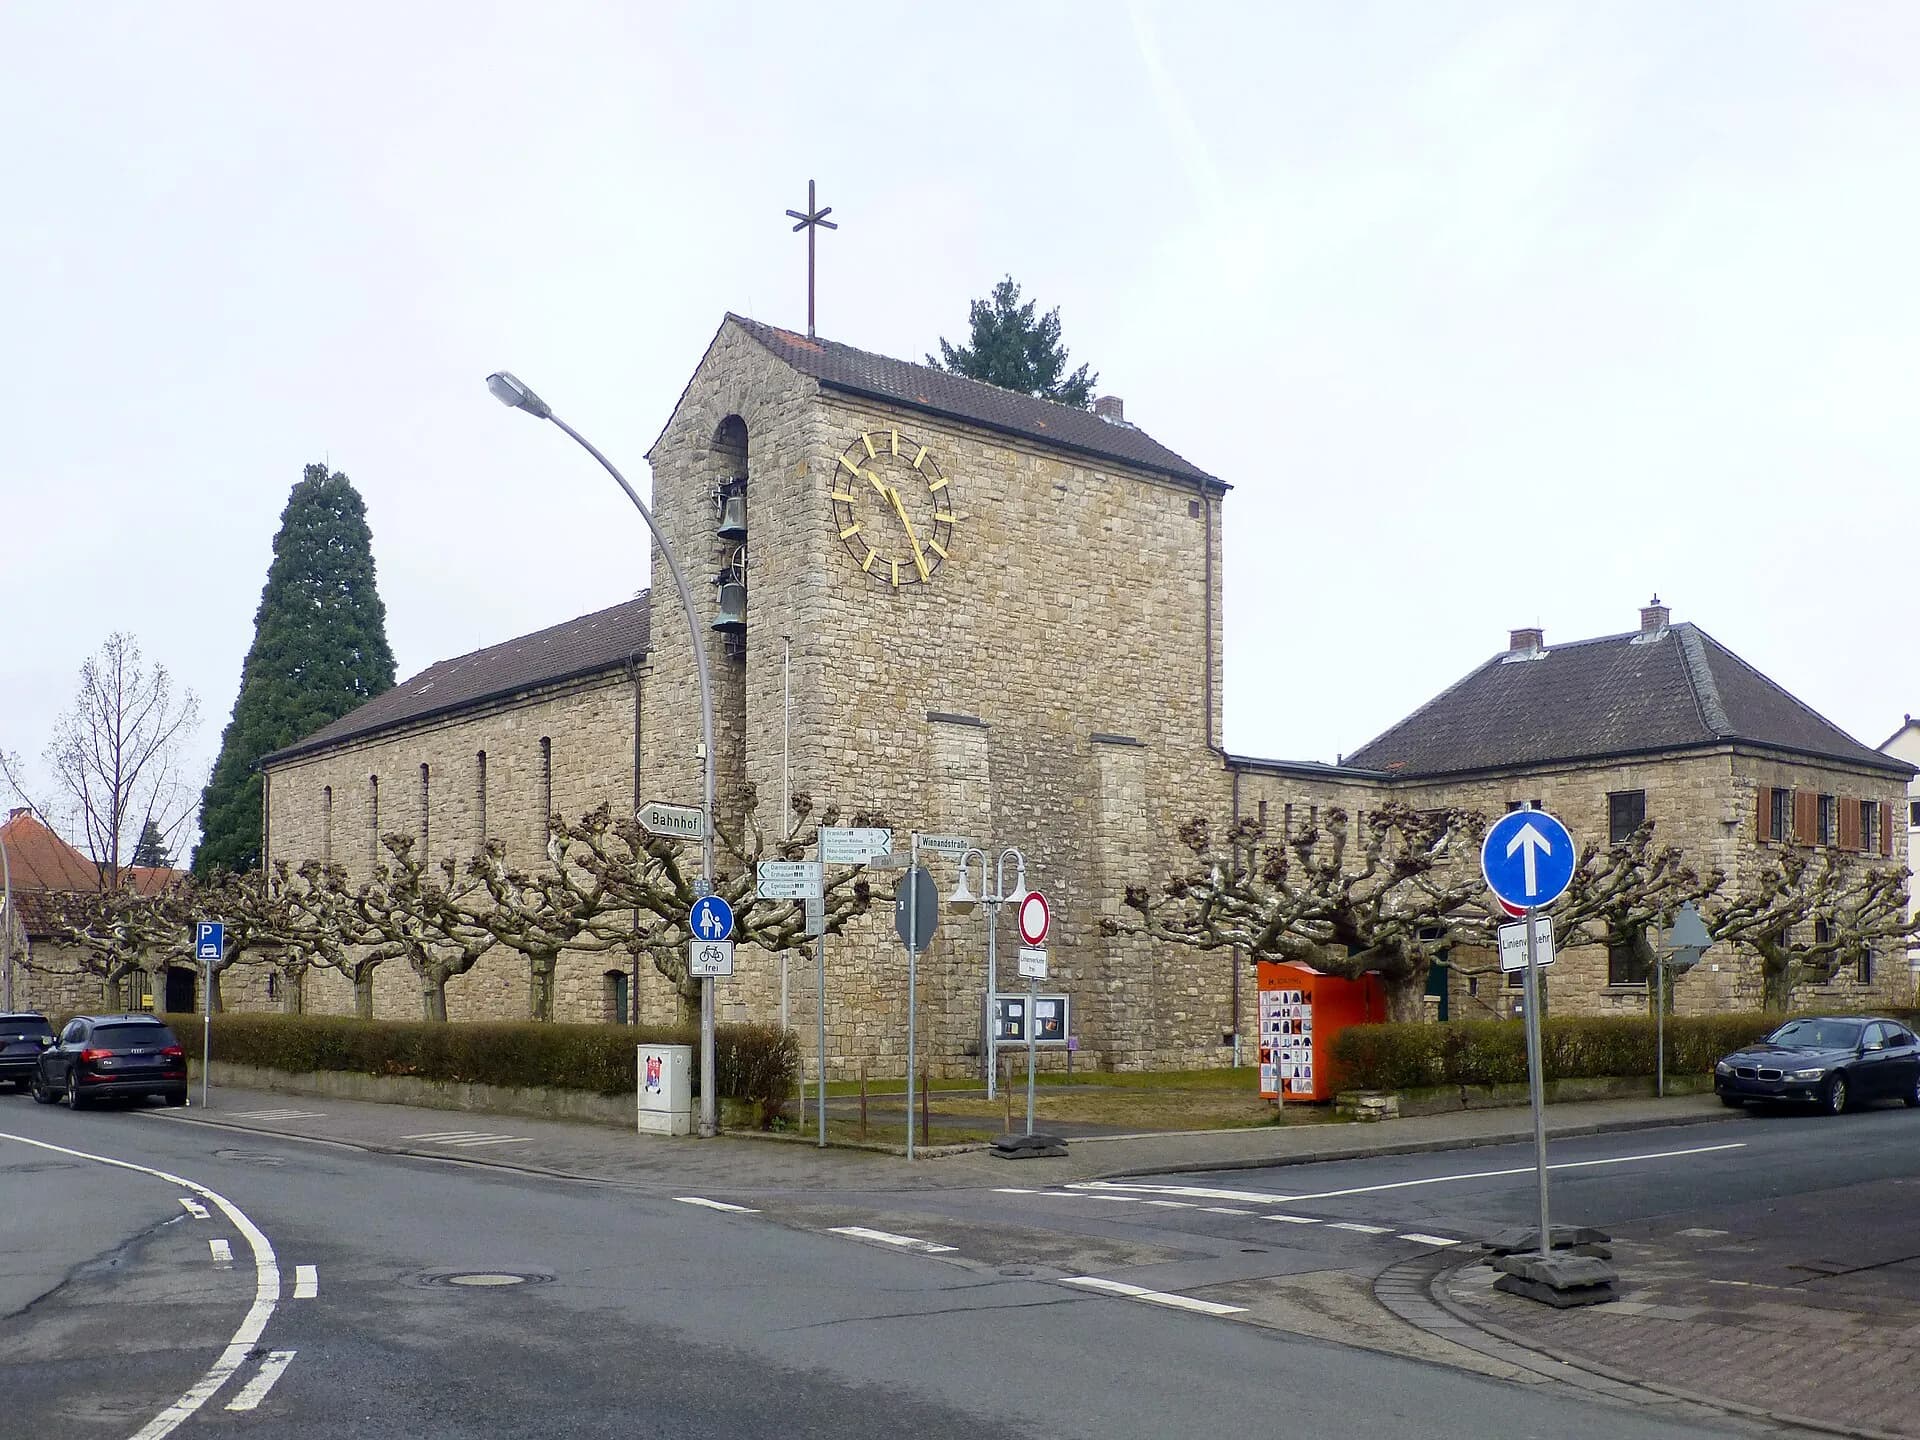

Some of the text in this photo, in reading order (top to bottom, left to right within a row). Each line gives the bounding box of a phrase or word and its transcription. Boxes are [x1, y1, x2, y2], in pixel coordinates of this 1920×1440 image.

[652, 811, 698, 830] Bahnhof
[201, 925, 213, 940] P
[1521, 952, 1529, 961] fr
[705, 963, 719, 972] frei
